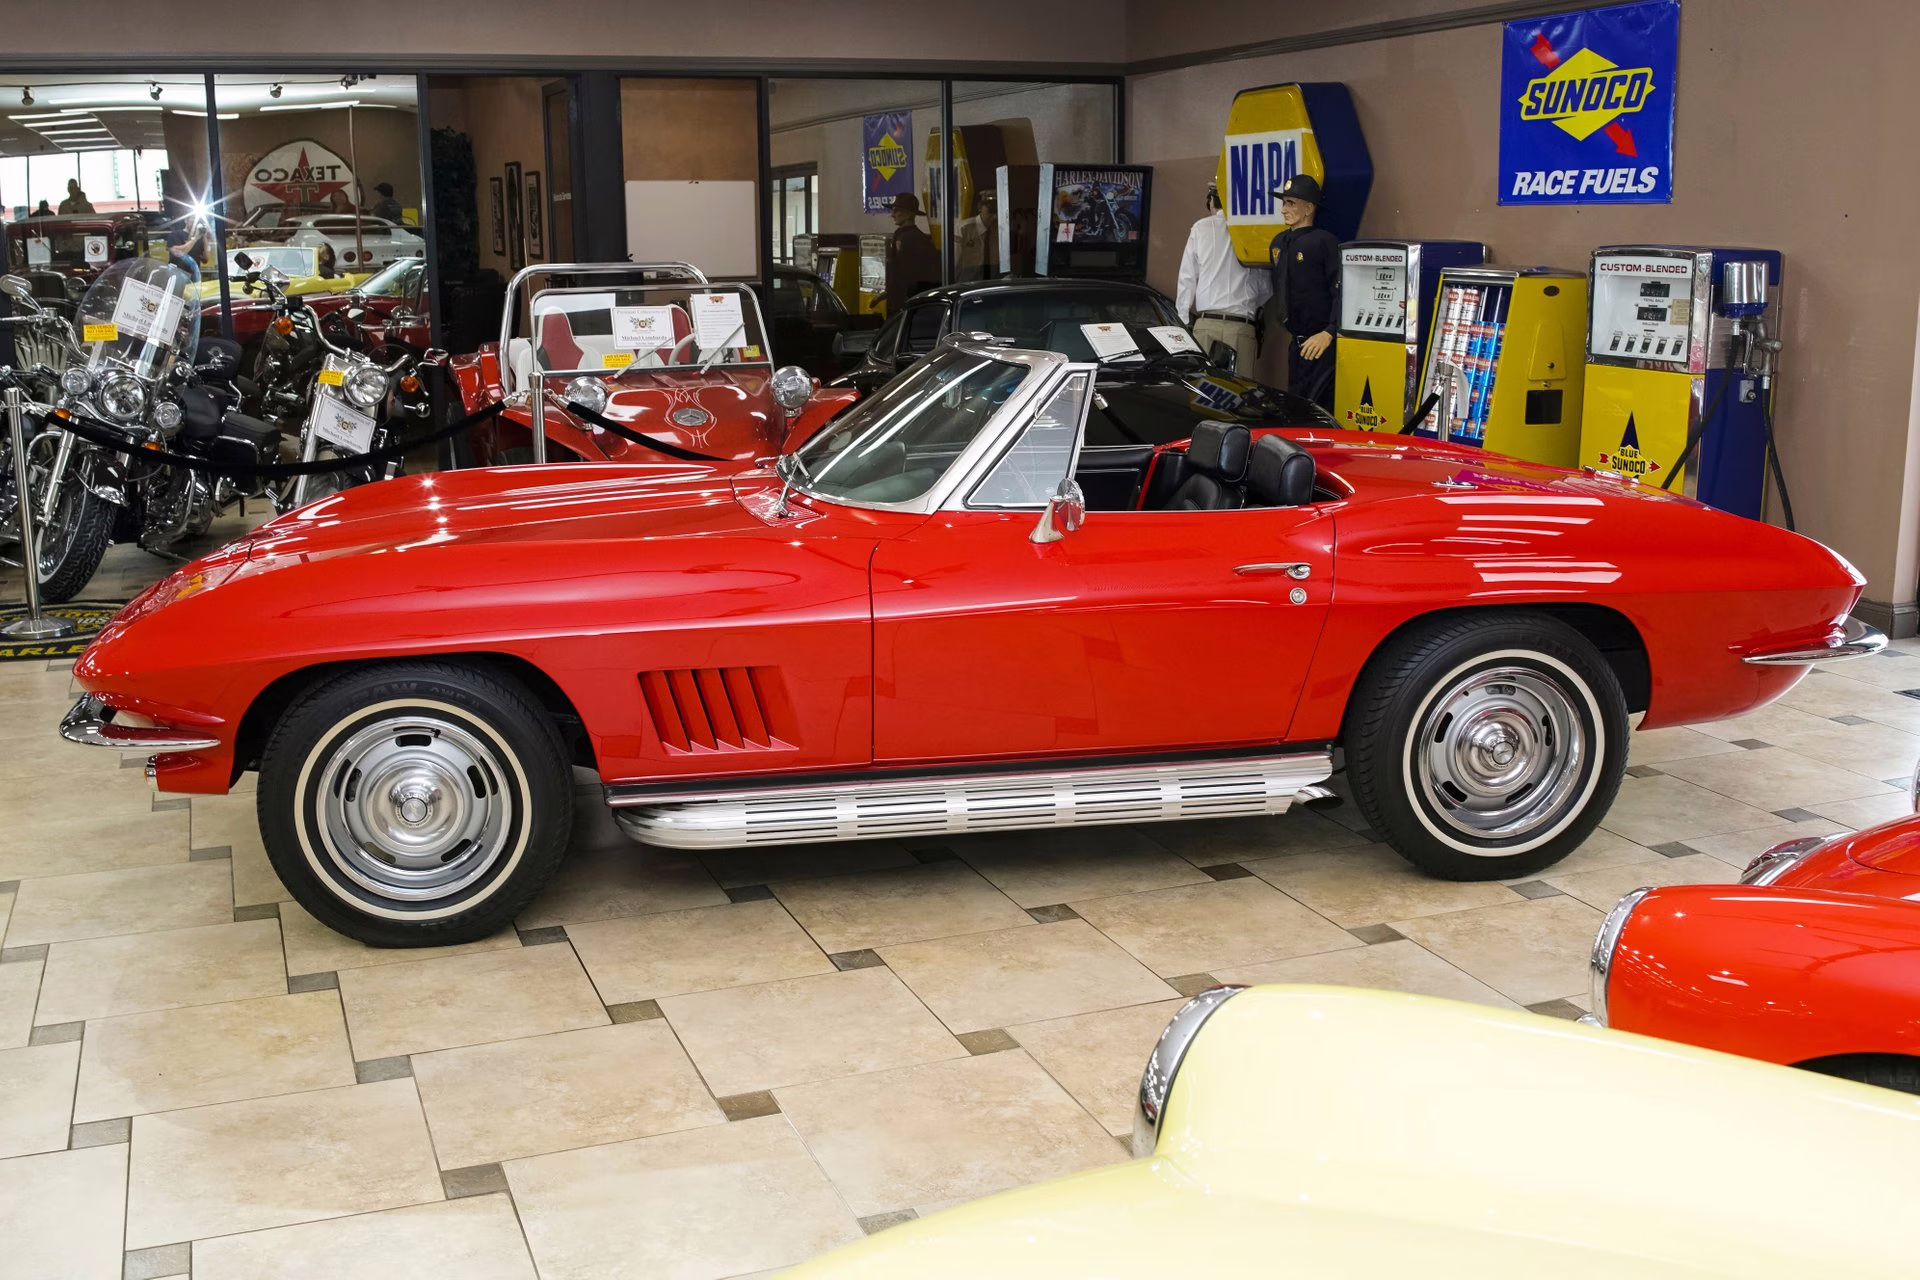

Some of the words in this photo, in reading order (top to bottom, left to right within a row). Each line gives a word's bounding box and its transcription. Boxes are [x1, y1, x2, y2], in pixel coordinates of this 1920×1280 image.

[1524, 72, 1649, 116] SUNOCO
[1055, 170, 1144, 188] HARLEY-DAVIDSON
[1230, 140, 1297, 216] NAPA
[1512, 169, 1580, 196] RACE
[1579, 166, 1659, 195] FUELS
[1600, 263, 1688, 274] CUSTOM-BLENDED
[1356, 412, 1378, 427] SUNOCO
[1620, 448, 1638, 458] BLUE
[1612, 456, 1646, 474] SUNOCO
